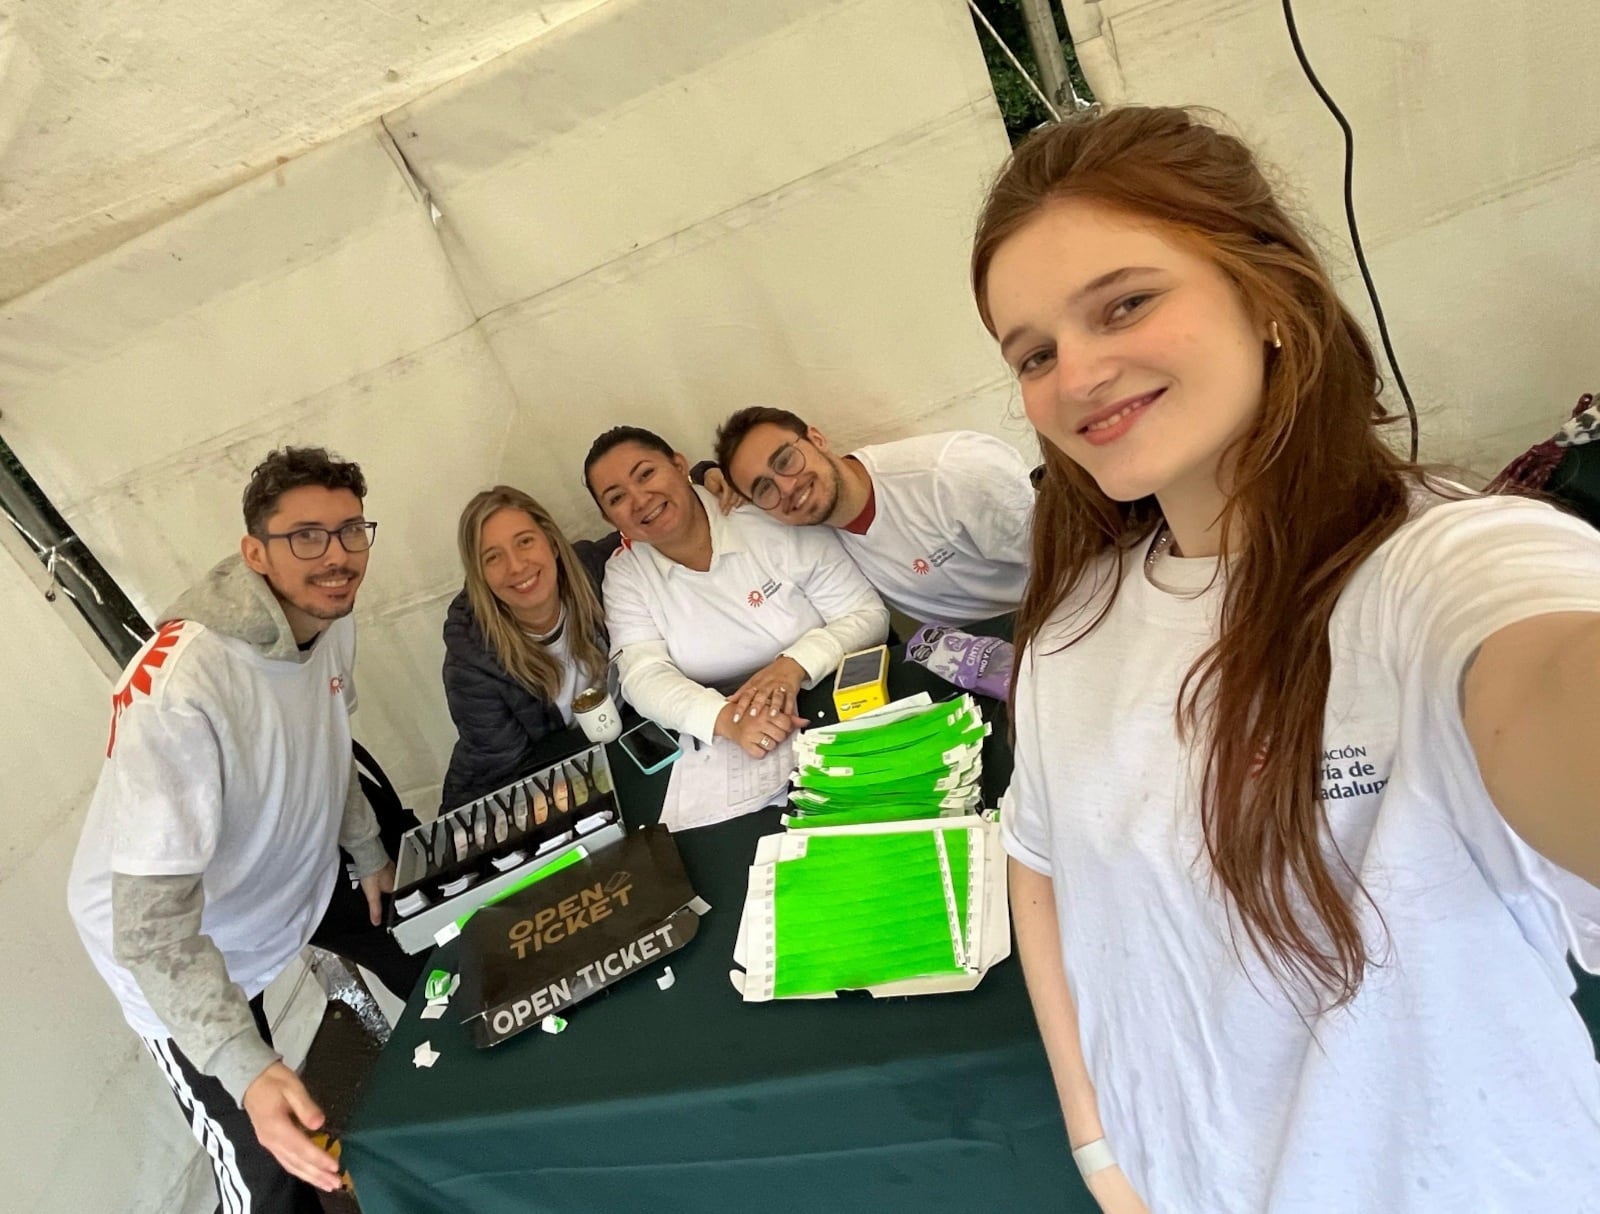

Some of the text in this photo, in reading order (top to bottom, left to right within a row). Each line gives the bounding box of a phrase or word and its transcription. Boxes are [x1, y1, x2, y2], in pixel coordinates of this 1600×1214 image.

[1320, 760, 1376, 780] ría de
[1322, 745, 1367, 760] ACIÓN
[1320, 775, 1390, 800] adalup
[508, 882, 604, 941] OPEN
[509, 884, 633, 960] TICKET
[492, 923, 674, 1035] OPEN TICKET
